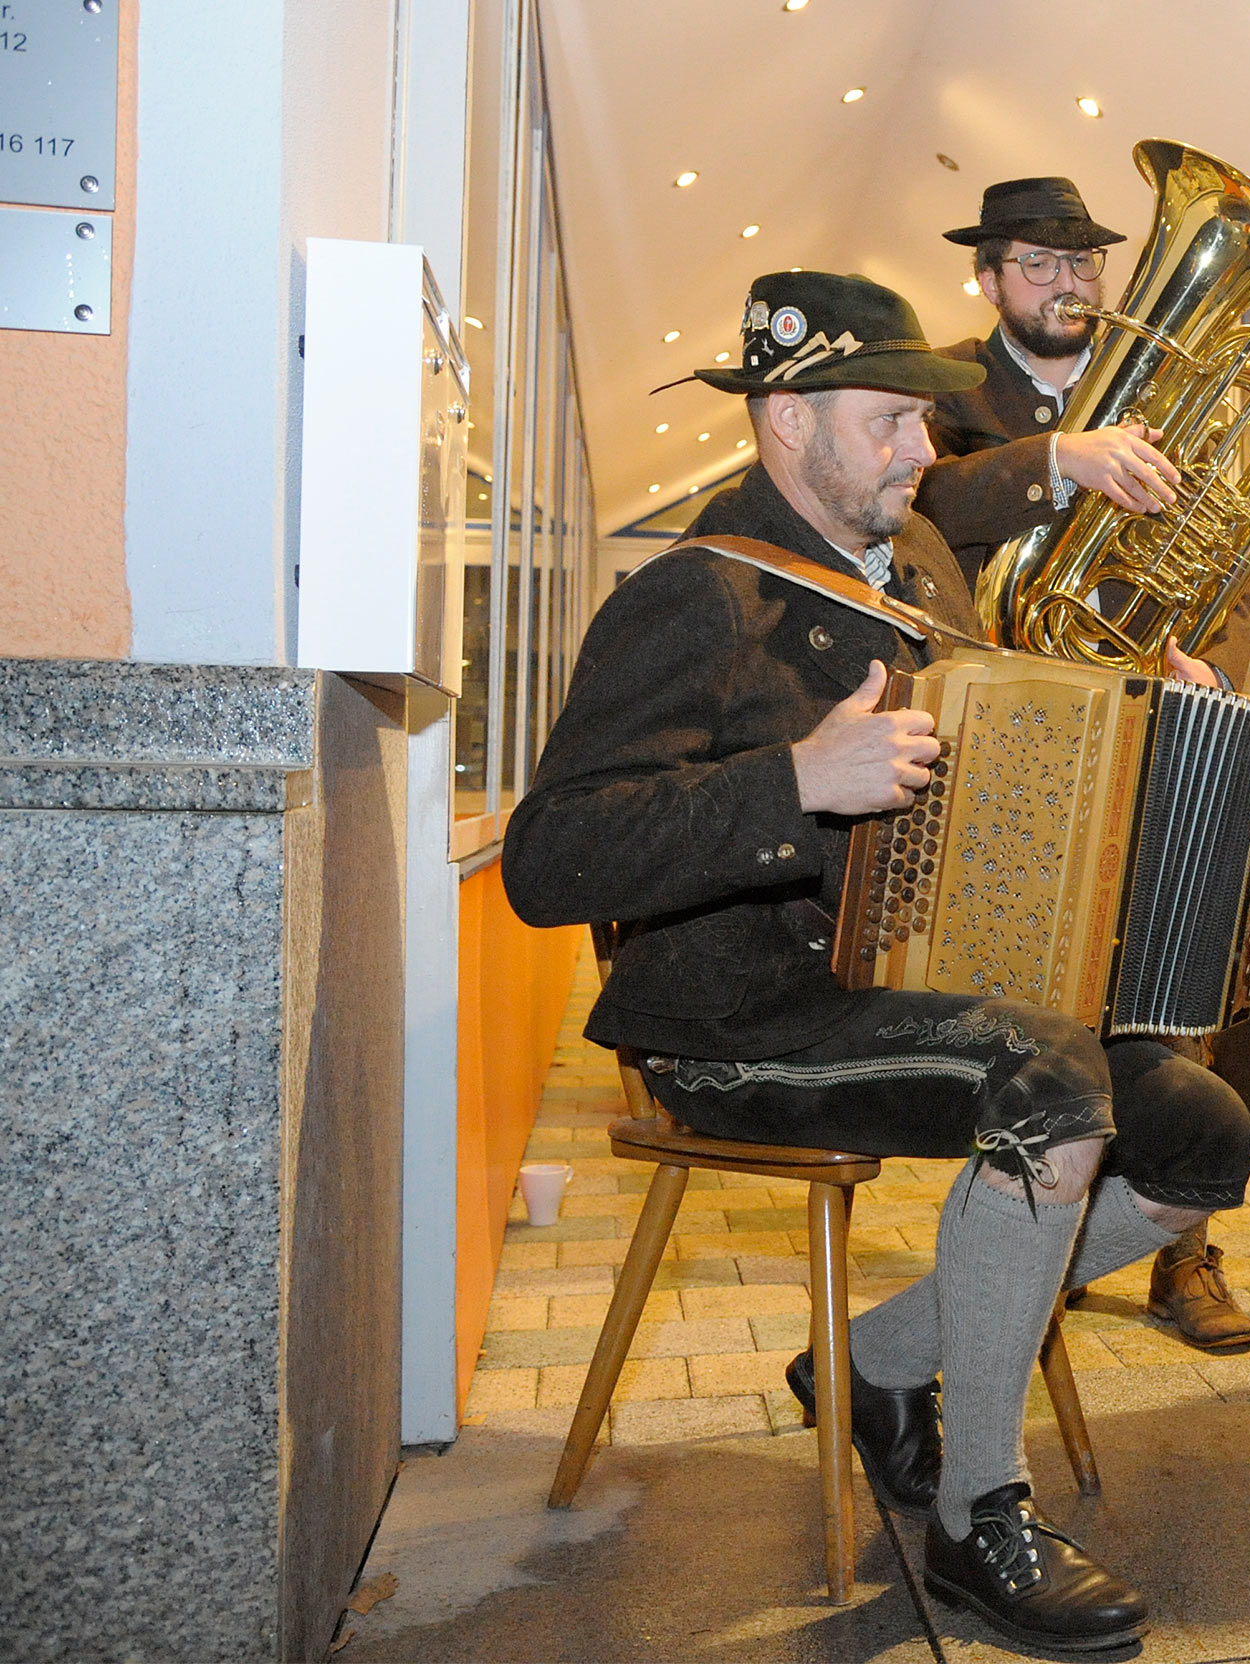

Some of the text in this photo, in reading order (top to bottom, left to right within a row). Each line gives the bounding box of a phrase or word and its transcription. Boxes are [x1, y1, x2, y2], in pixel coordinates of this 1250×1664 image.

[0, 31, 27, 52] 12
[0, 133, 75, 157] 16 117
